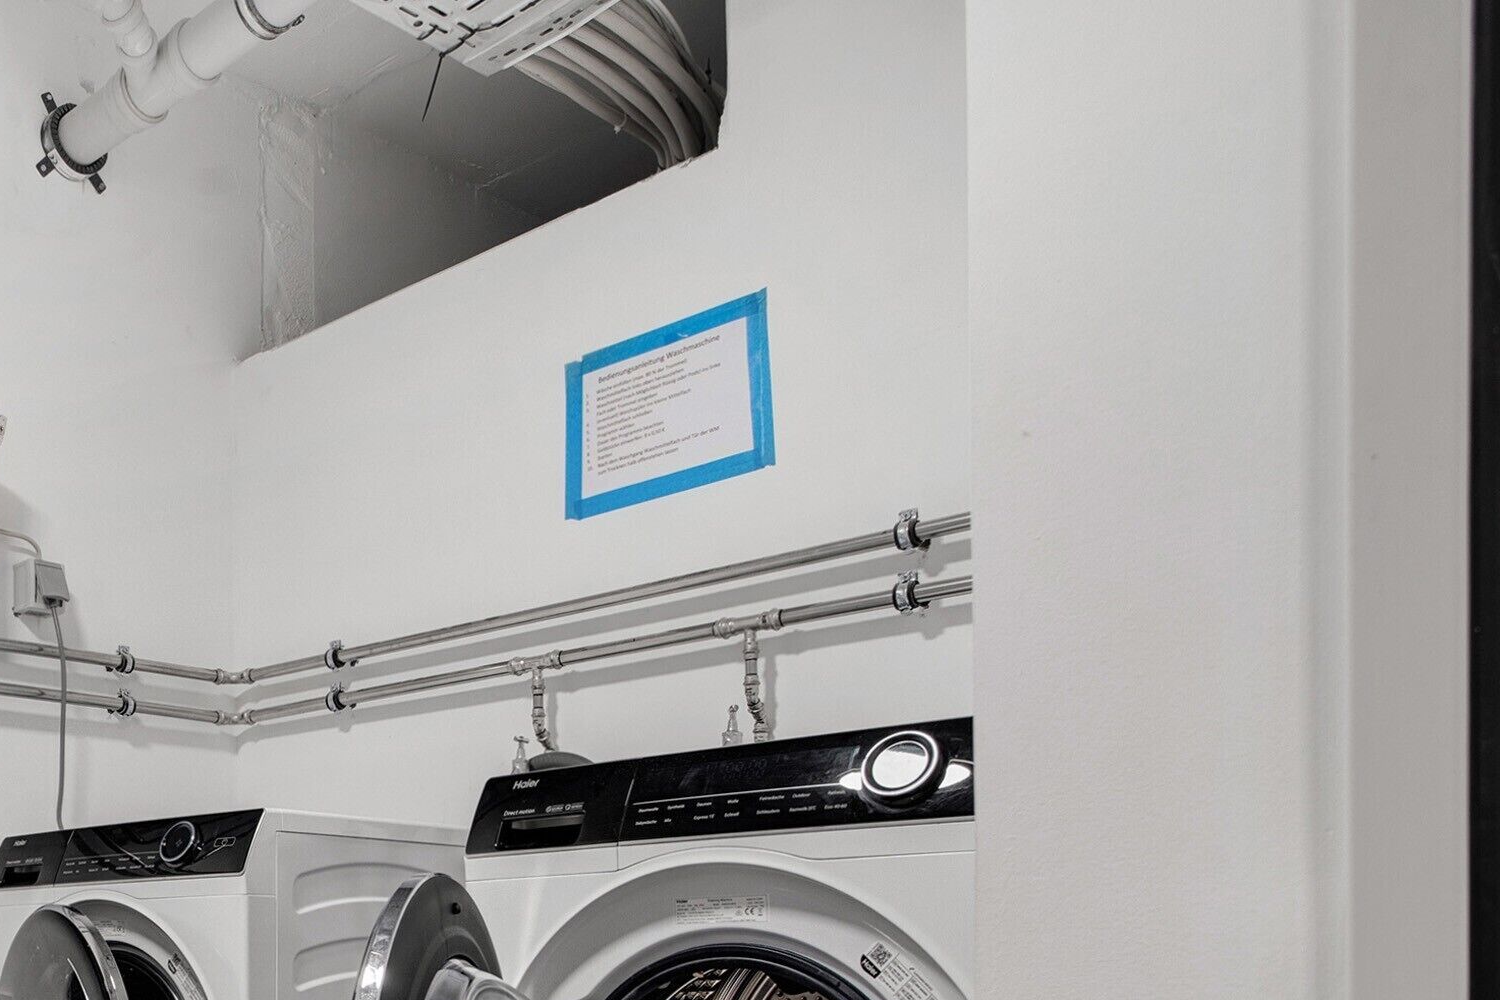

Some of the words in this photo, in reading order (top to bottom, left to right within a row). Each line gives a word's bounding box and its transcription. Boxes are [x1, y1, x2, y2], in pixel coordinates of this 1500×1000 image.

[598, 354, 664, 383] Bedienungsanleitung
[665, 333, 719, 359] Waschmaschine
[512, 779, 540, 790] Haier
[503, 809, 519, 817] Direct
[862, 958, 879, 976] Haier
